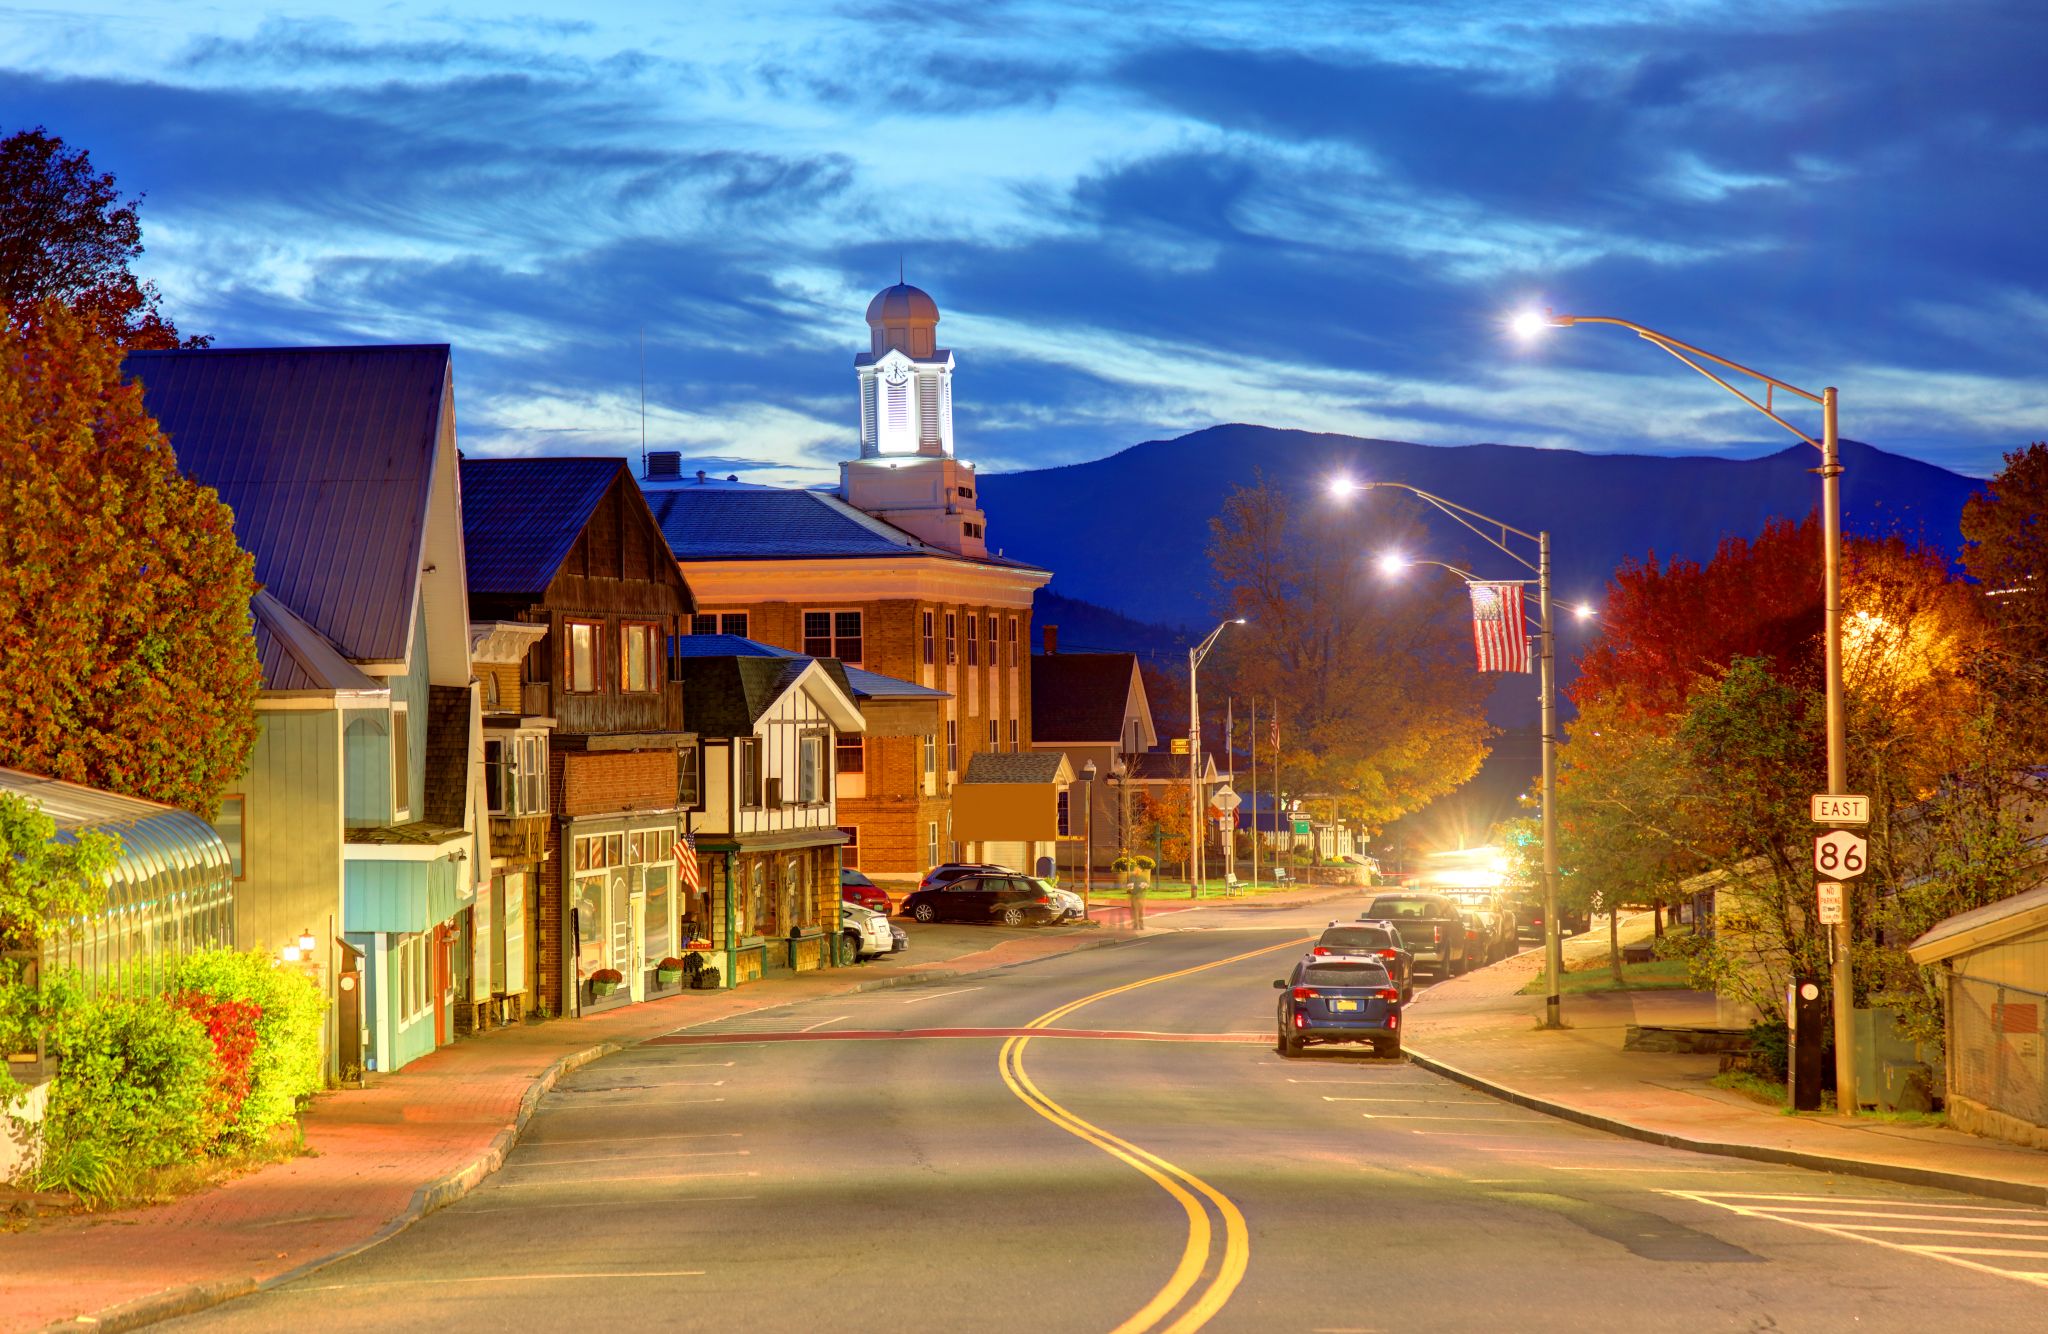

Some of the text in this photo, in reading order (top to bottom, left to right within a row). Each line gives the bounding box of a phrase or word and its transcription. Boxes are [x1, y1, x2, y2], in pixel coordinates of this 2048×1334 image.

[1821, 801, 1860, 817] EAST
[1820, 842, 1863, 872] 86
[1826, 887, 1835, 895] NO
[1820, 896, 1841, 905] PARKING
